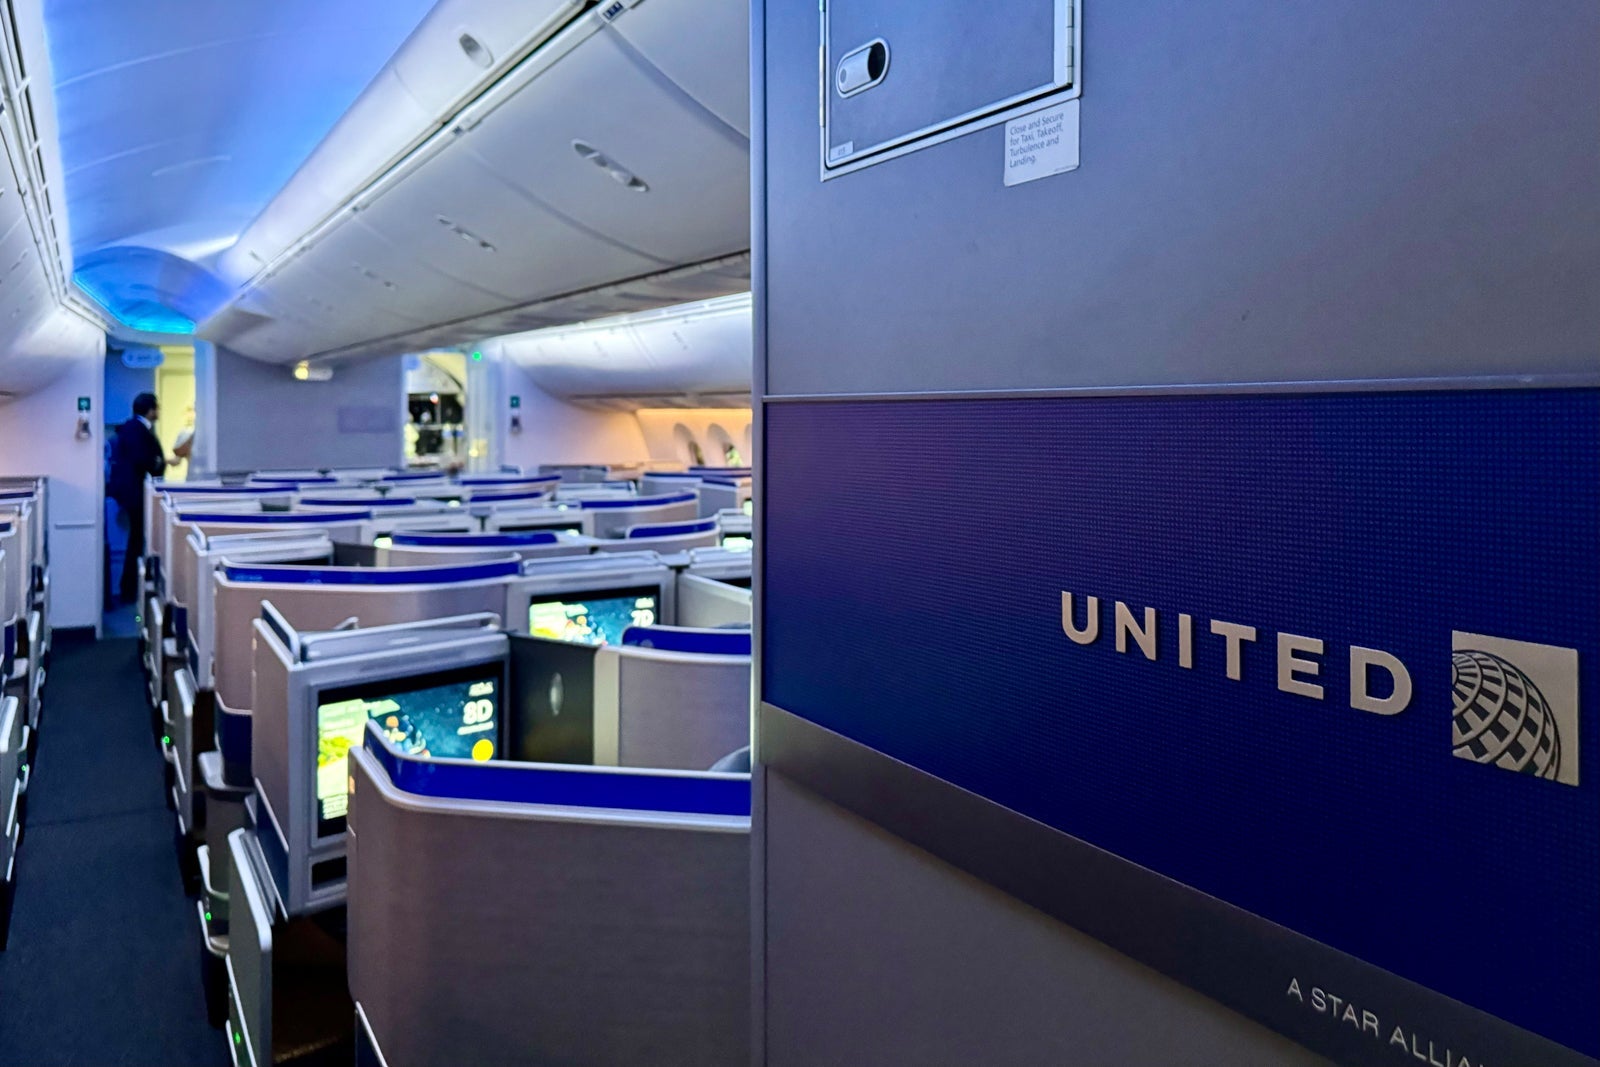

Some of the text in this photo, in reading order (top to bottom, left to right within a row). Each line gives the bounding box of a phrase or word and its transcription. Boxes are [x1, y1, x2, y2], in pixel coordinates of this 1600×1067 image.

[1010, 112, 1064, 136] Close and Secure
[1010, 136, 1020, 146] for
[1010, 134, 1059, 157] Turbulence and
[1061, 590, 1413, 716] UNITED
[463, 699, 494, 725] 8D
[1287, 977, 1484, 1067] A STAR ALLIA
